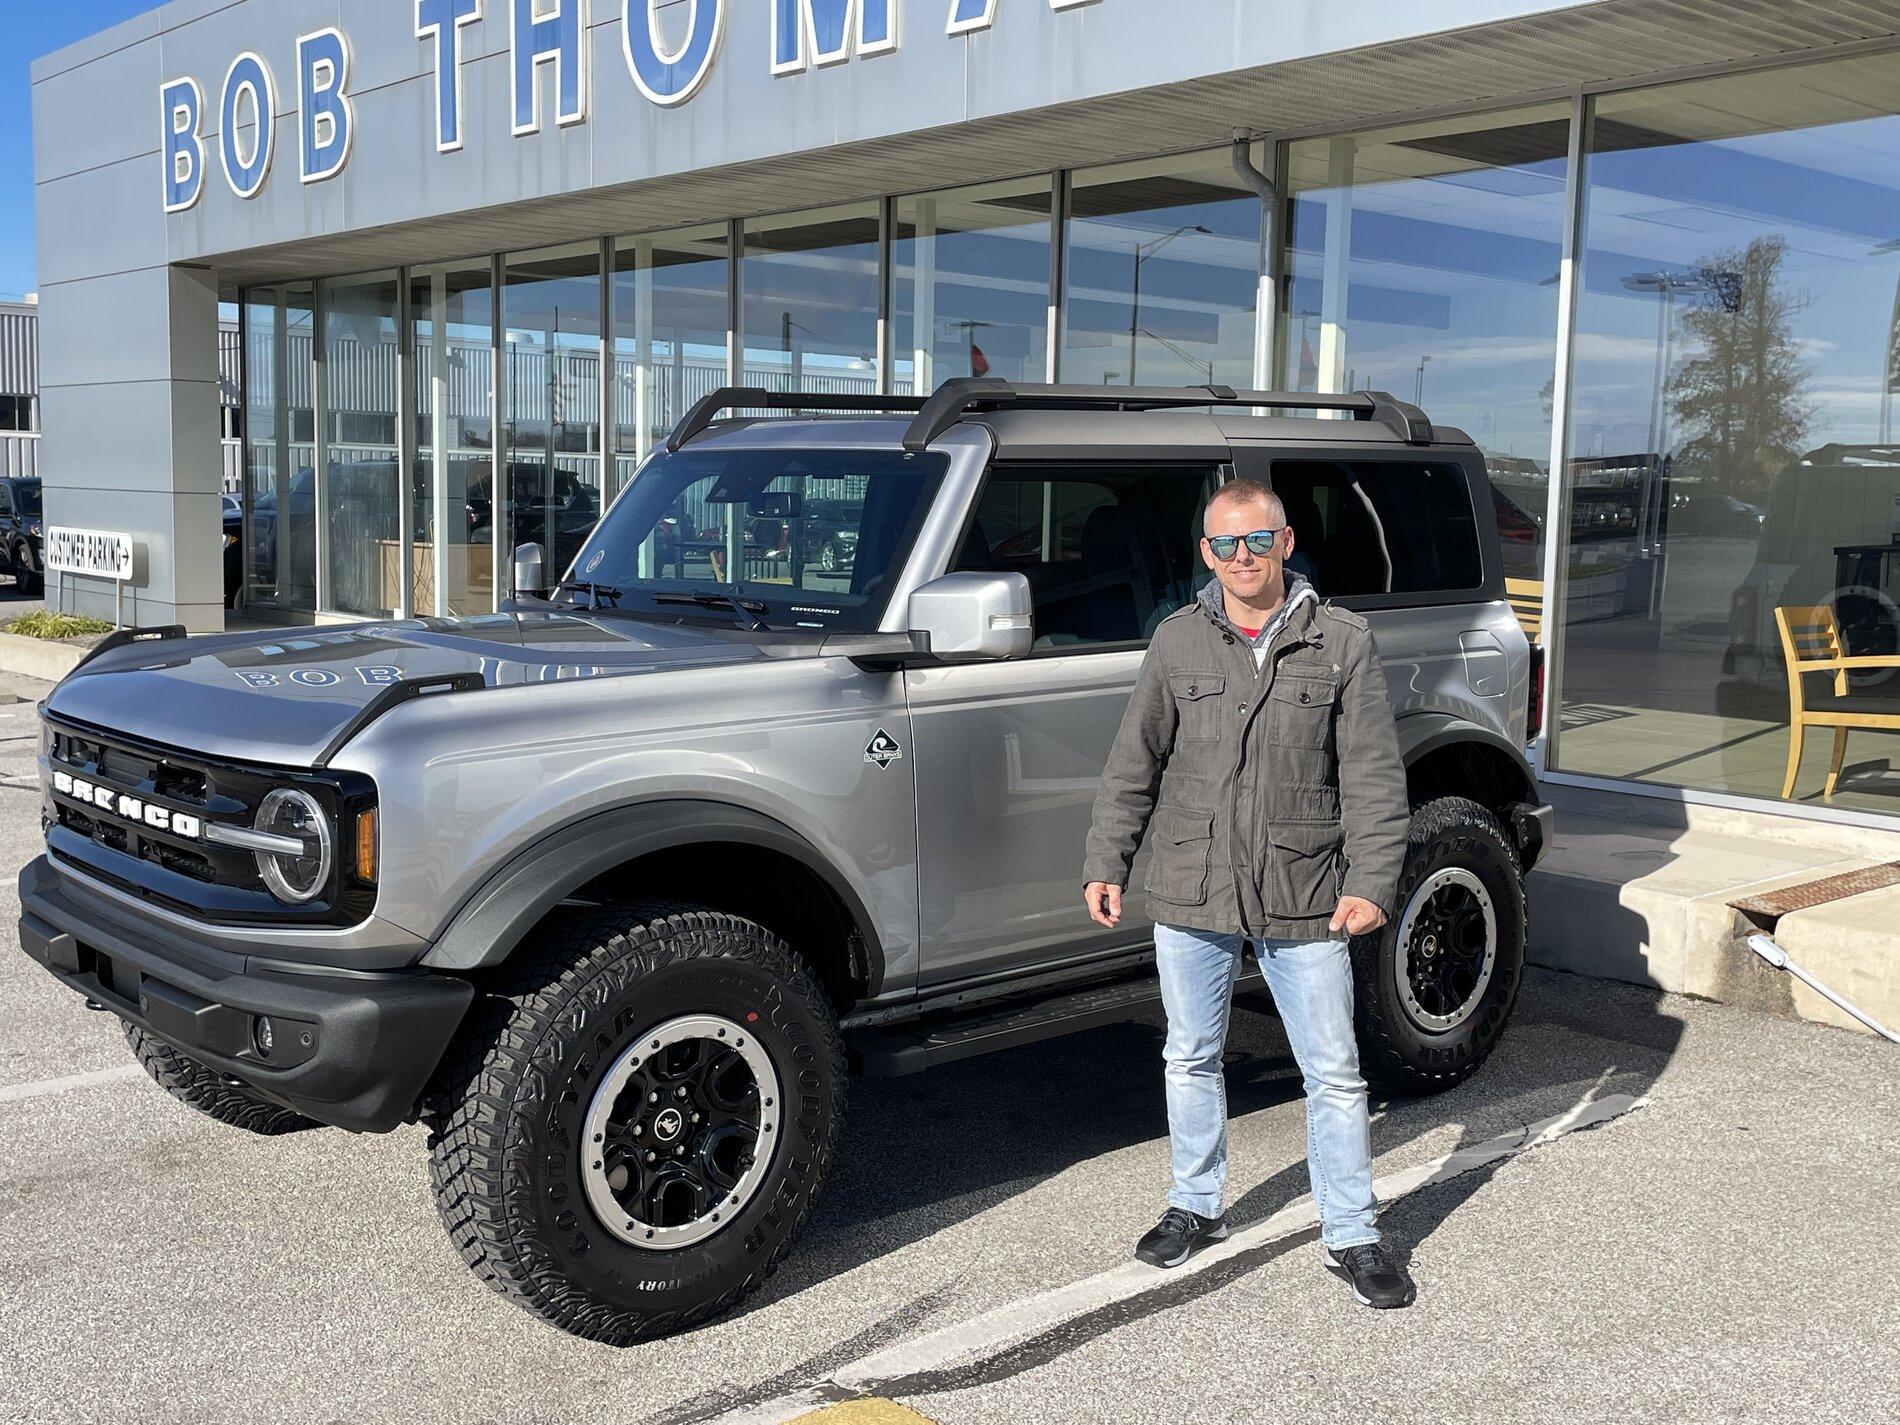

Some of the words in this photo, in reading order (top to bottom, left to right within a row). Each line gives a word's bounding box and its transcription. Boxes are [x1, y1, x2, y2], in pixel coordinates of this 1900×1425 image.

[160, 27, 353, 212] BOB
[50, 531, 85, 568] CUSTOMER
[88, 535, 121, 573] PARKING
[53, 770, 200, 838] BRONCO
